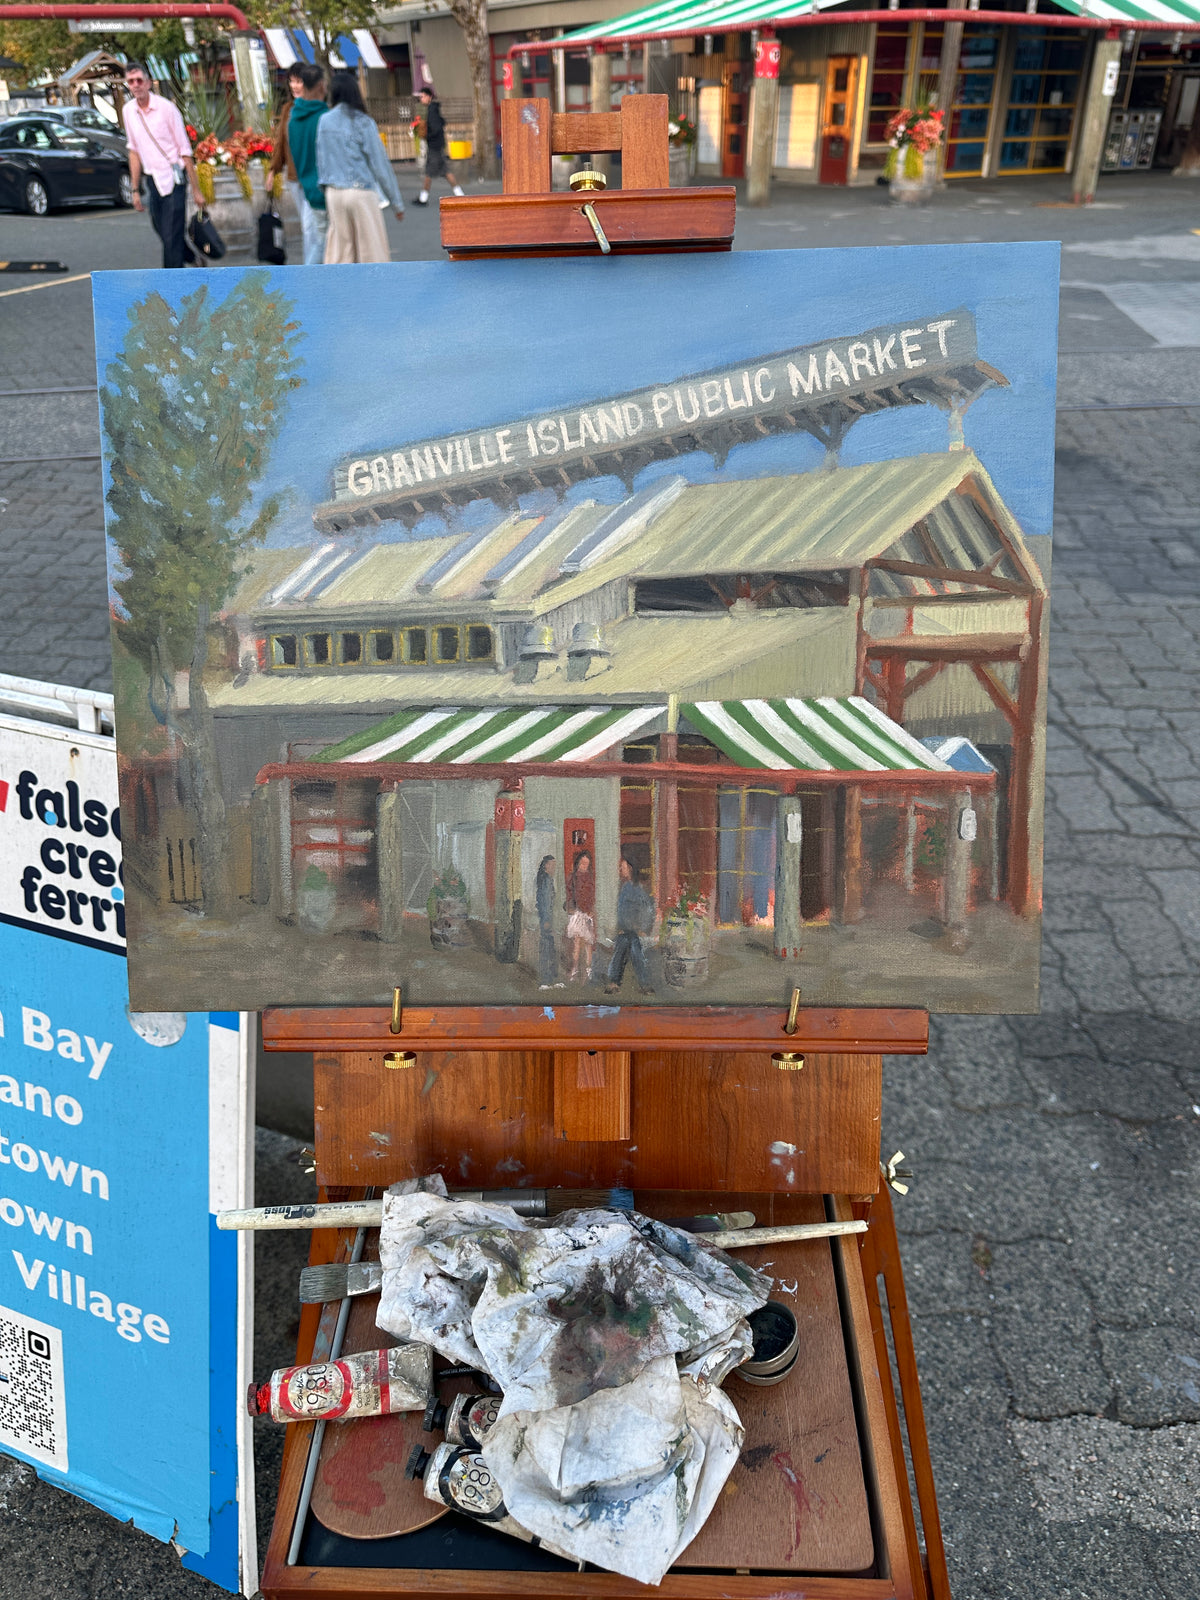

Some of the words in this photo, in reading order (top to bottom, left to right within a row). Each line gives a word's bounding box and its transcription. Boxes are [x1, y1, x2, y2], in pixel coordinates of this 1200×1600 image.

[348, 430, 515, 496] GRANVILLE
[526, 401, 643, 458] ISLAND
[651, 367, 775, 428] PUBLIC
[787, 319, 957, 397] MARKET
[16, 770, 122, 842] fals
[40, 838, 124, 888] cre
[22, 1006, 114, 1081] Bay
[11, 1249, 171, 1344] Village
[306, 1364, 328, 1415] 1980
